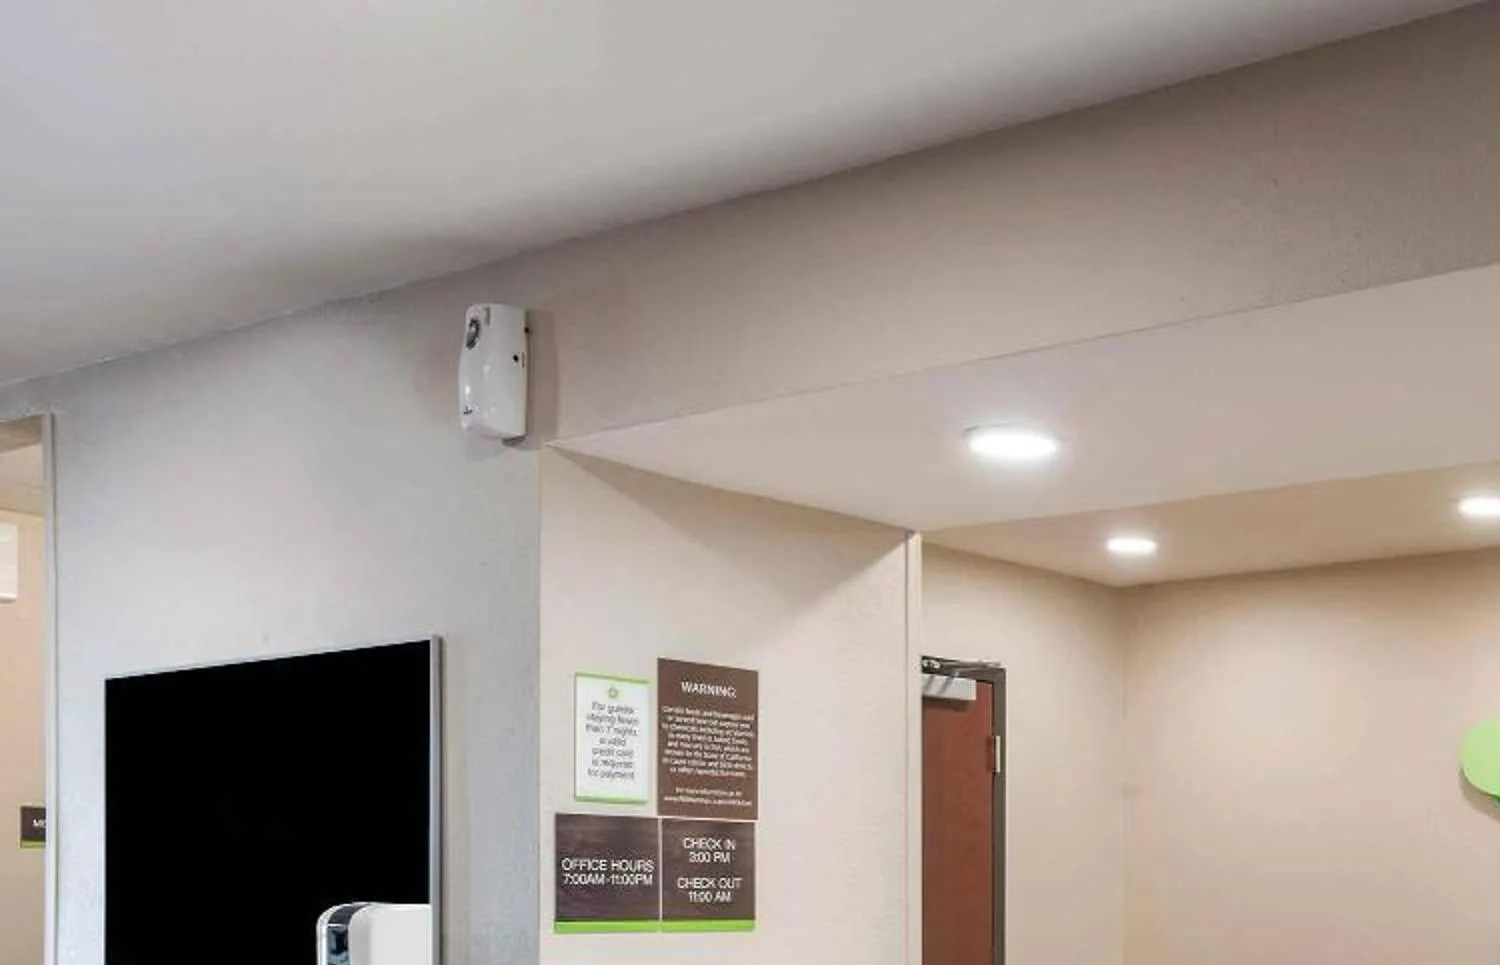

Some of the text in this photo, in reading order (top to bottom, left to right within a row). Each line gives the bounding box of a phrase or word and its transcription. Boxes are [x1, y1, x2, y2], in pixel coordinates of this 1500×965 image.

[683, 837, 722, 850] CHECK
[689, 851, 731, 864] 3:00 PM
[561, 857, 655, 873] OFFICE HOURS
[677, 877, 743, 889] CHECK OUT
[713, 891, 732, 903] AM
